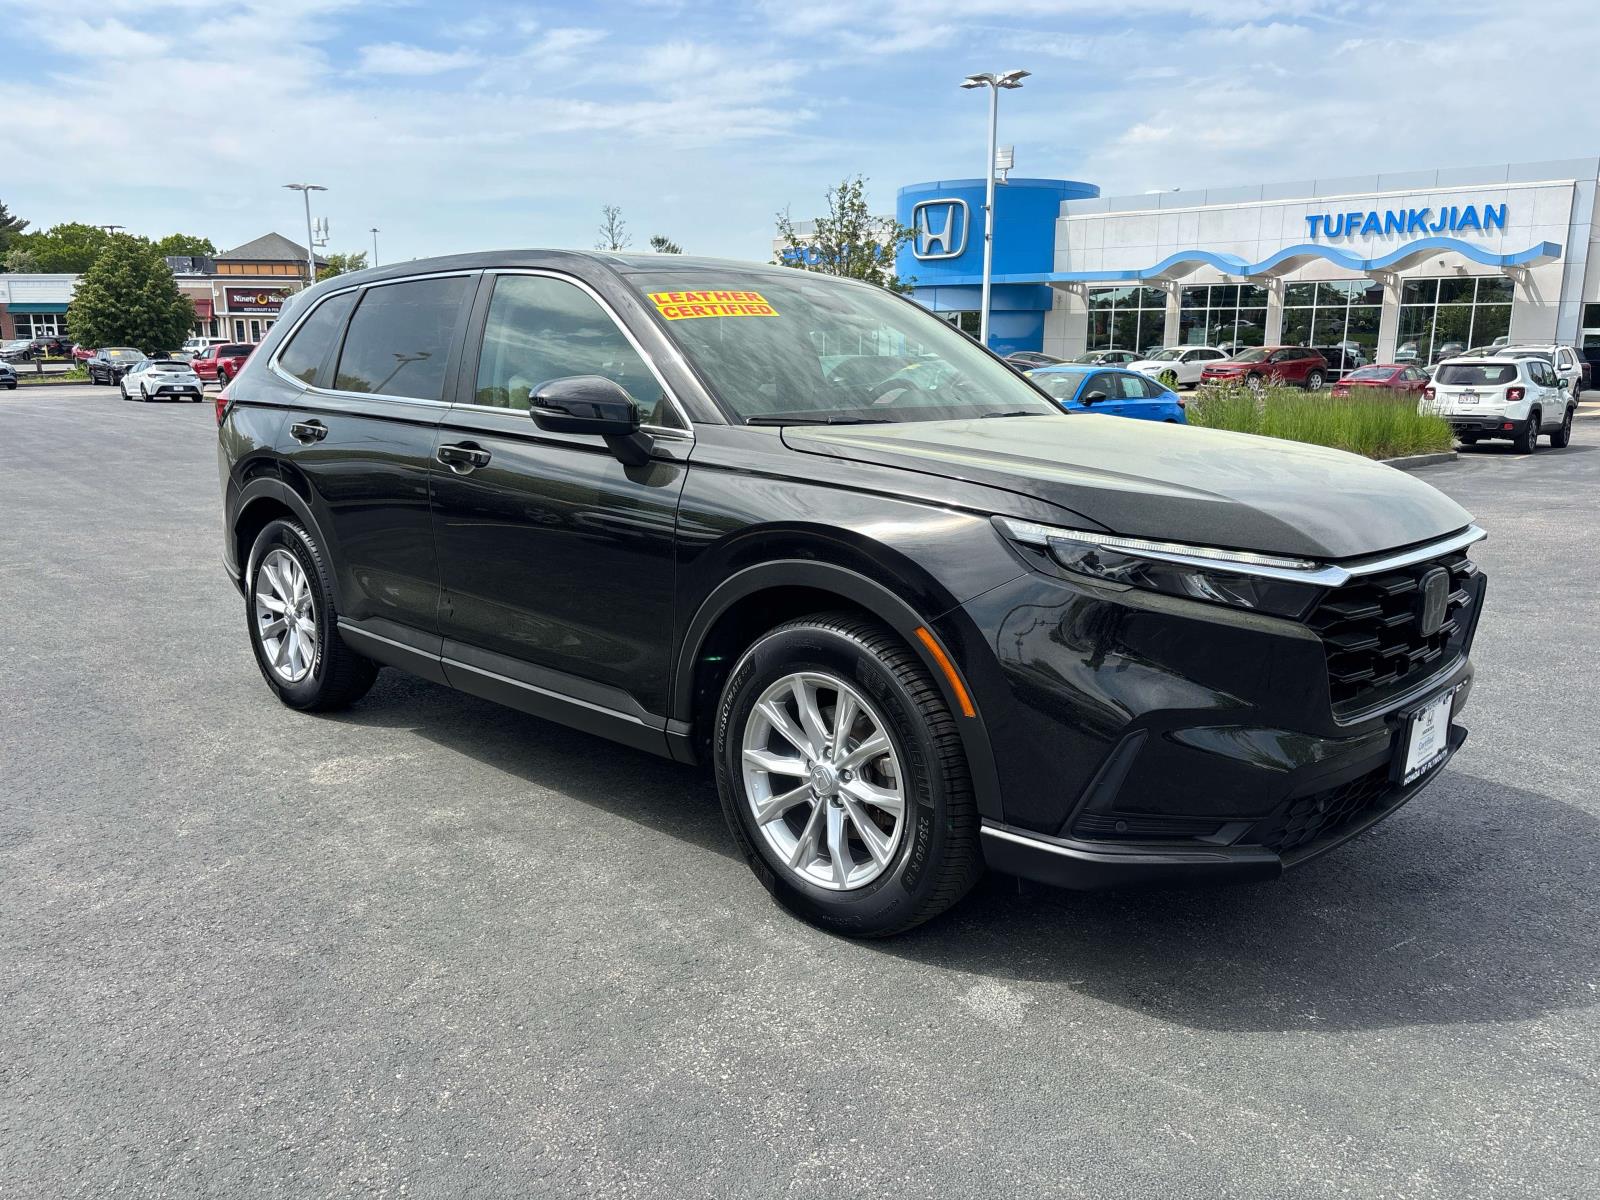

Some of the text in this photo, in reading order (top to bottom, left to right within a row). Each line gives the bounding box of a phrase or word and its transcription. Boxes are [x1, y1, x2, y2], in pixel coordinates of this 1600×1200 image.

[1305, 203, 1506, 239] TUFANKJIAN
[233, 295, 257, 304] Ninety
[653, 291, 763, 305] LEATHER
[662, 304, 774, 318] CERTIFIED
[718, 676, 743, 753] CROSSCLIMATE
[915, 816, 929, 861] 235/60
